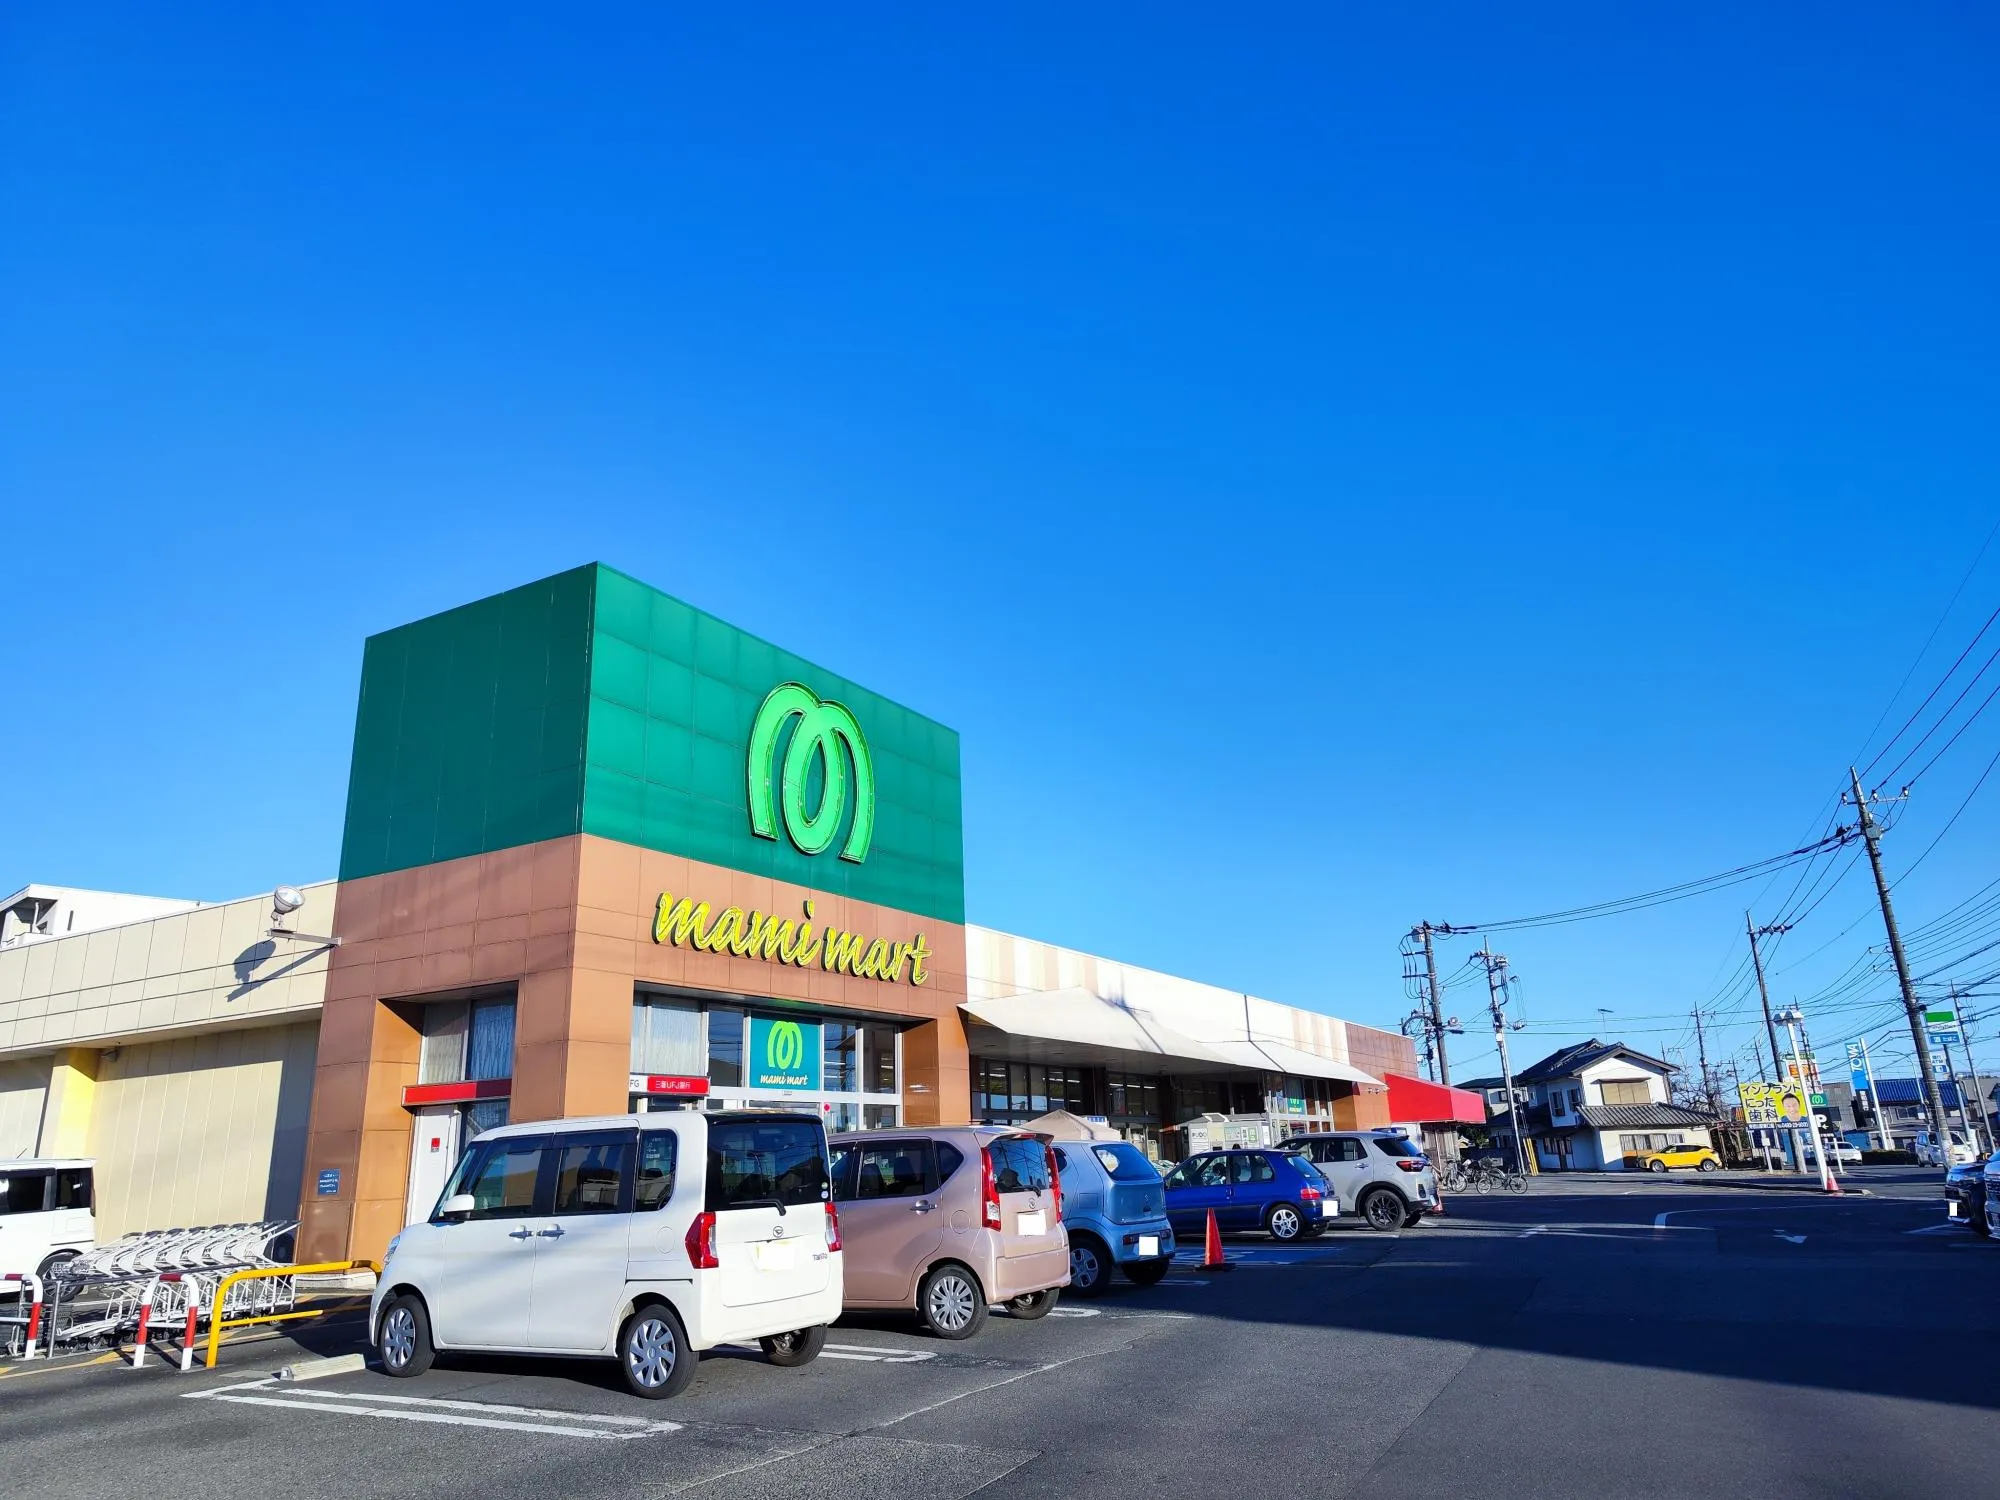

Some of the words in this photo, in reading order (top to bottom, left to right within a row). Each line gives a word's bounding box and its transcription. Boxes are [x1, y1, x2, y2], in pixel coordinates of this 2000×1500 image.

[652, 891, 821, 967] mami
[821, 926, 932, 986] mart
[760, 1072, 787, 1084] mami
[786, 1074, 808, 1085] mart
[1742, 1082, 1801, 1096] インプラント
[1745, 1097, 1777, 1108] にった
[1748, 1108, 1779, 1122] 歯科
